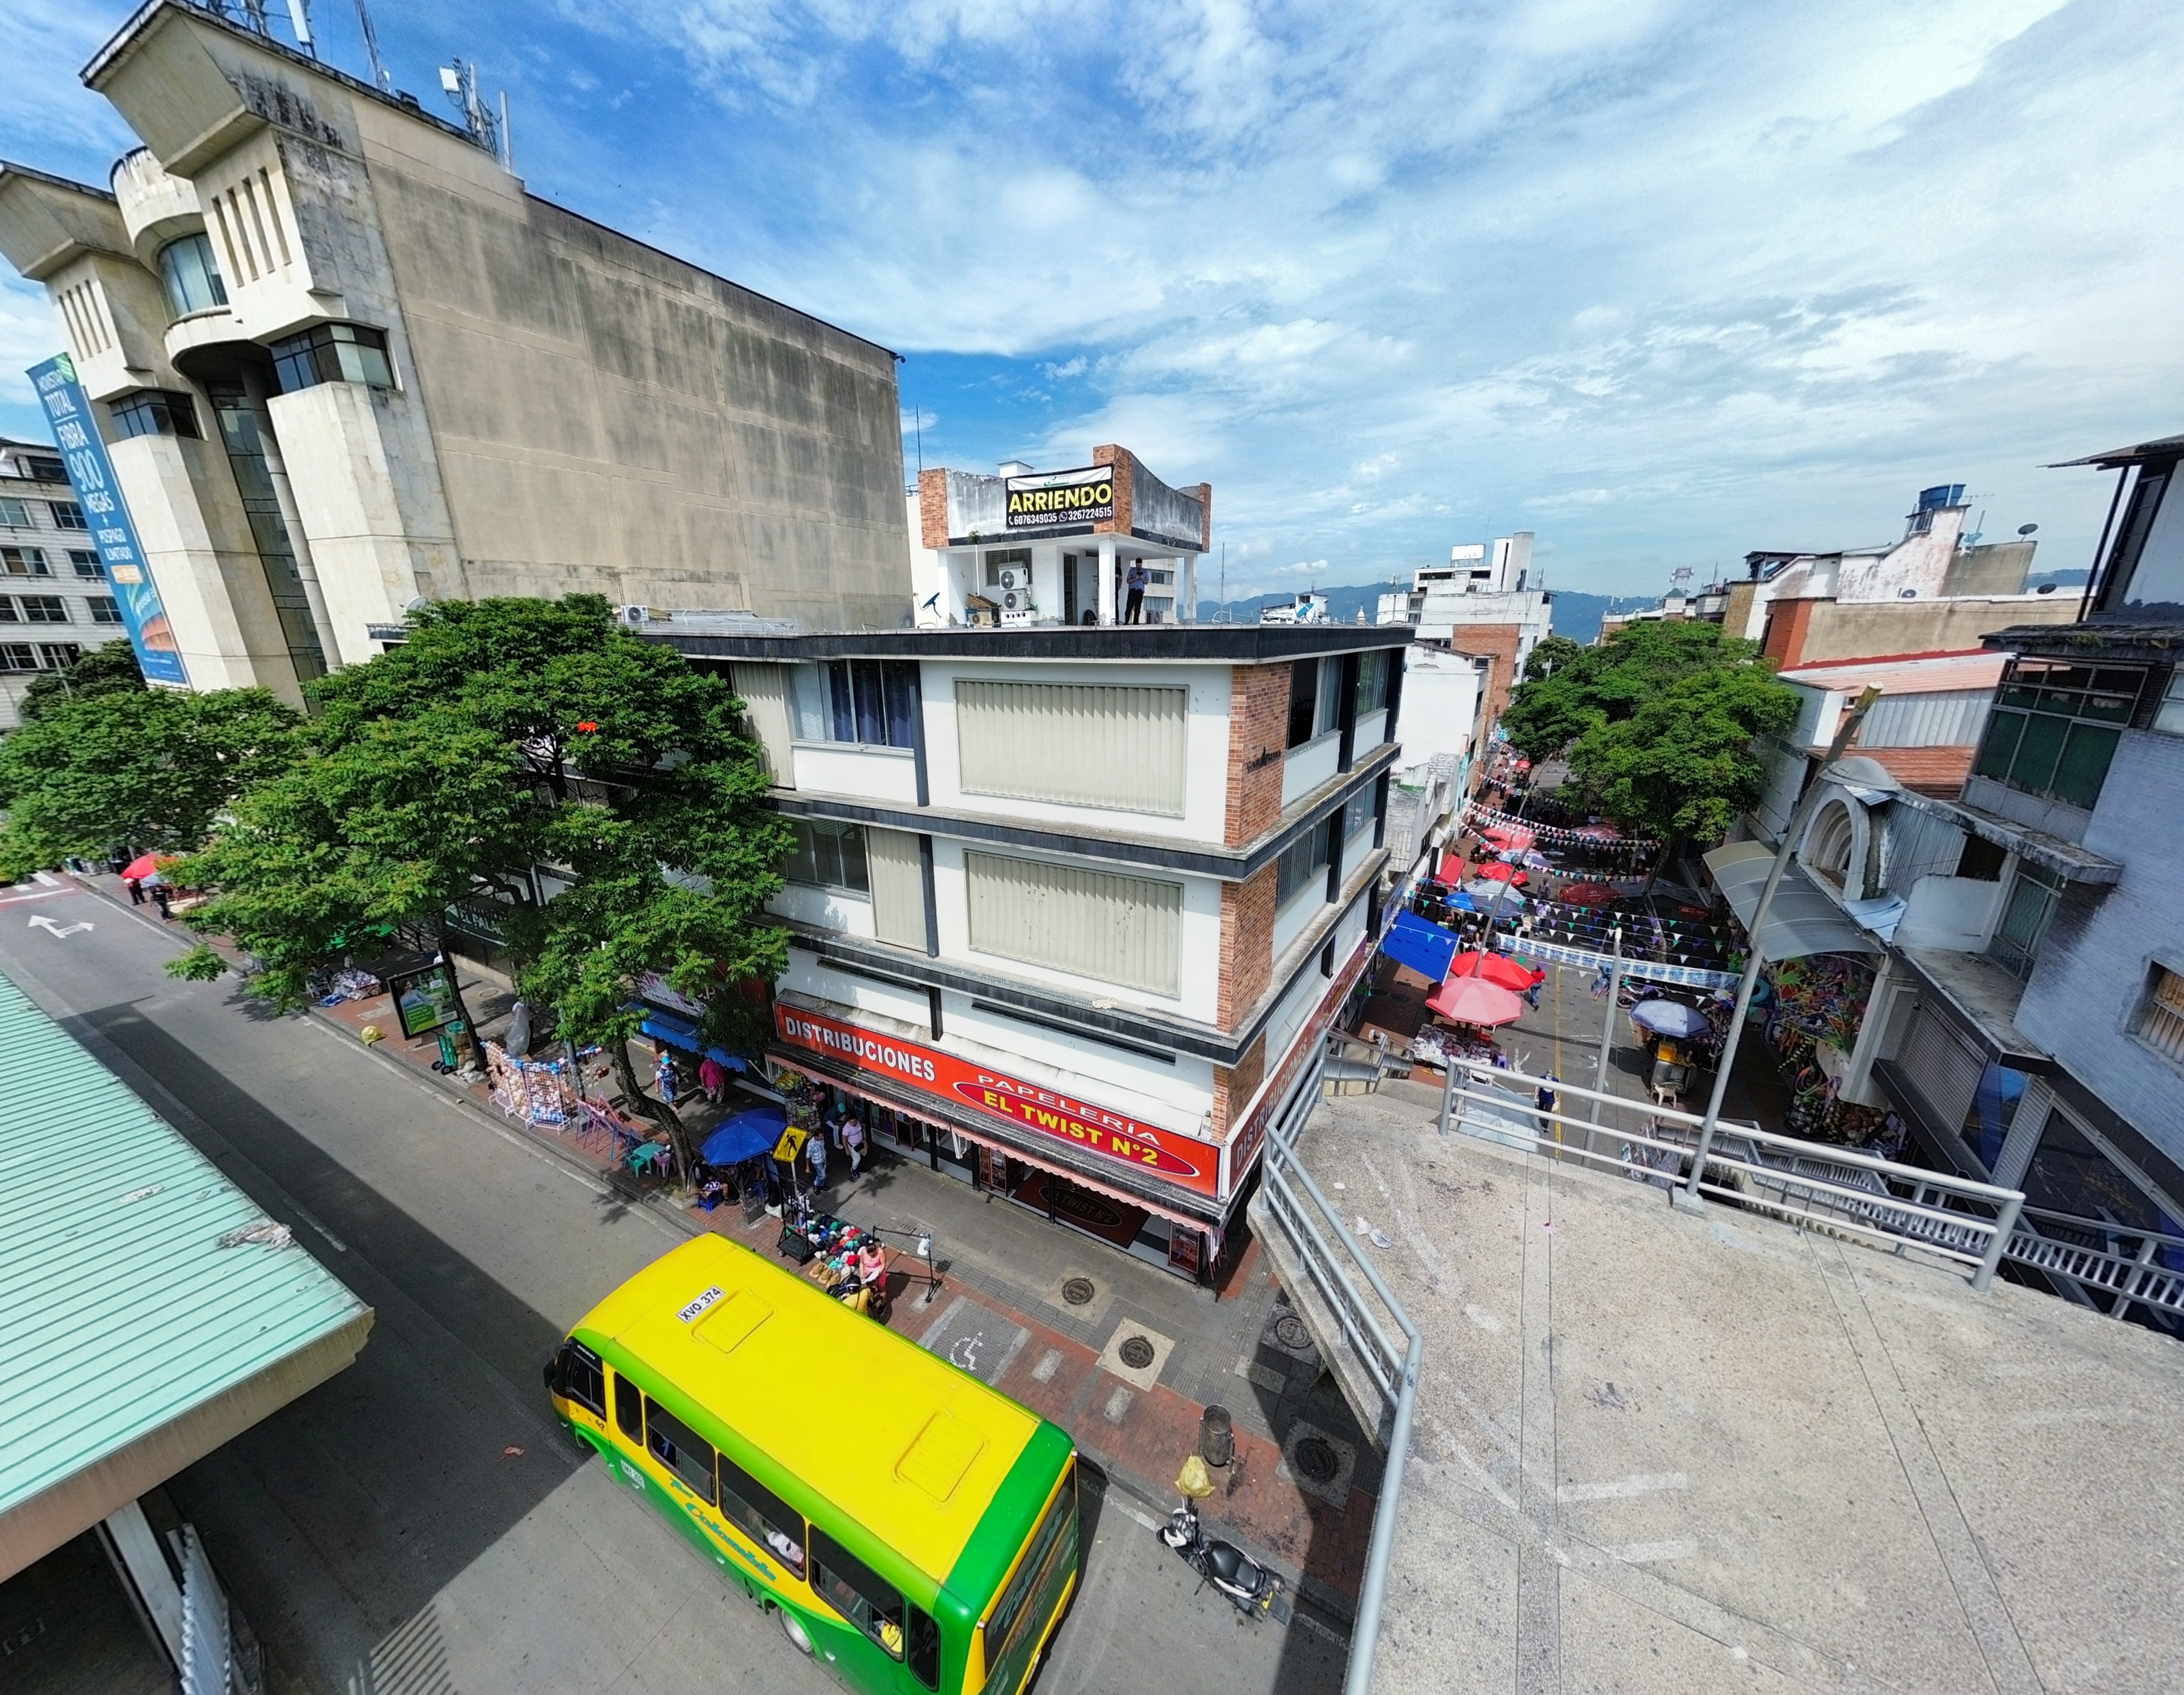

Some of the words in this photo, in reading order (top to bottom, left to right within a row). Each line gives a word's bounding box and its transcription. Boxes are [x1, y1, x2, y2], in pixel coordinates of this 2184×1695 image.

[44, 389, 77, 418] TOTAL
[57, 420, 90, 450] FIBRA
[69, 449, 104, 492] 900
[83, 490, 114, 513] MEGAS
[1008, 483, 1112, 513] ARRIENDO
[1014, 513, 1057, 525] 6076349035
[1068, 506, 1112, 521] 3267224515
[785, 1016, 935, 1082] DISTRIBUCIONES
[978, 1074, 1161, 1146] PAPELERÍA
[984, 1091, 1013, 1113] EL
[1020, 1103, 1103, 1145] TWIST
[1236, 1037, 1307, 1170] DISTRIBUCIONES
[1061, 1195, 1096, 1214] TWIST
[680, 1303, 702, 1320] XVO
[701, 1288, 721, 1304] 374
